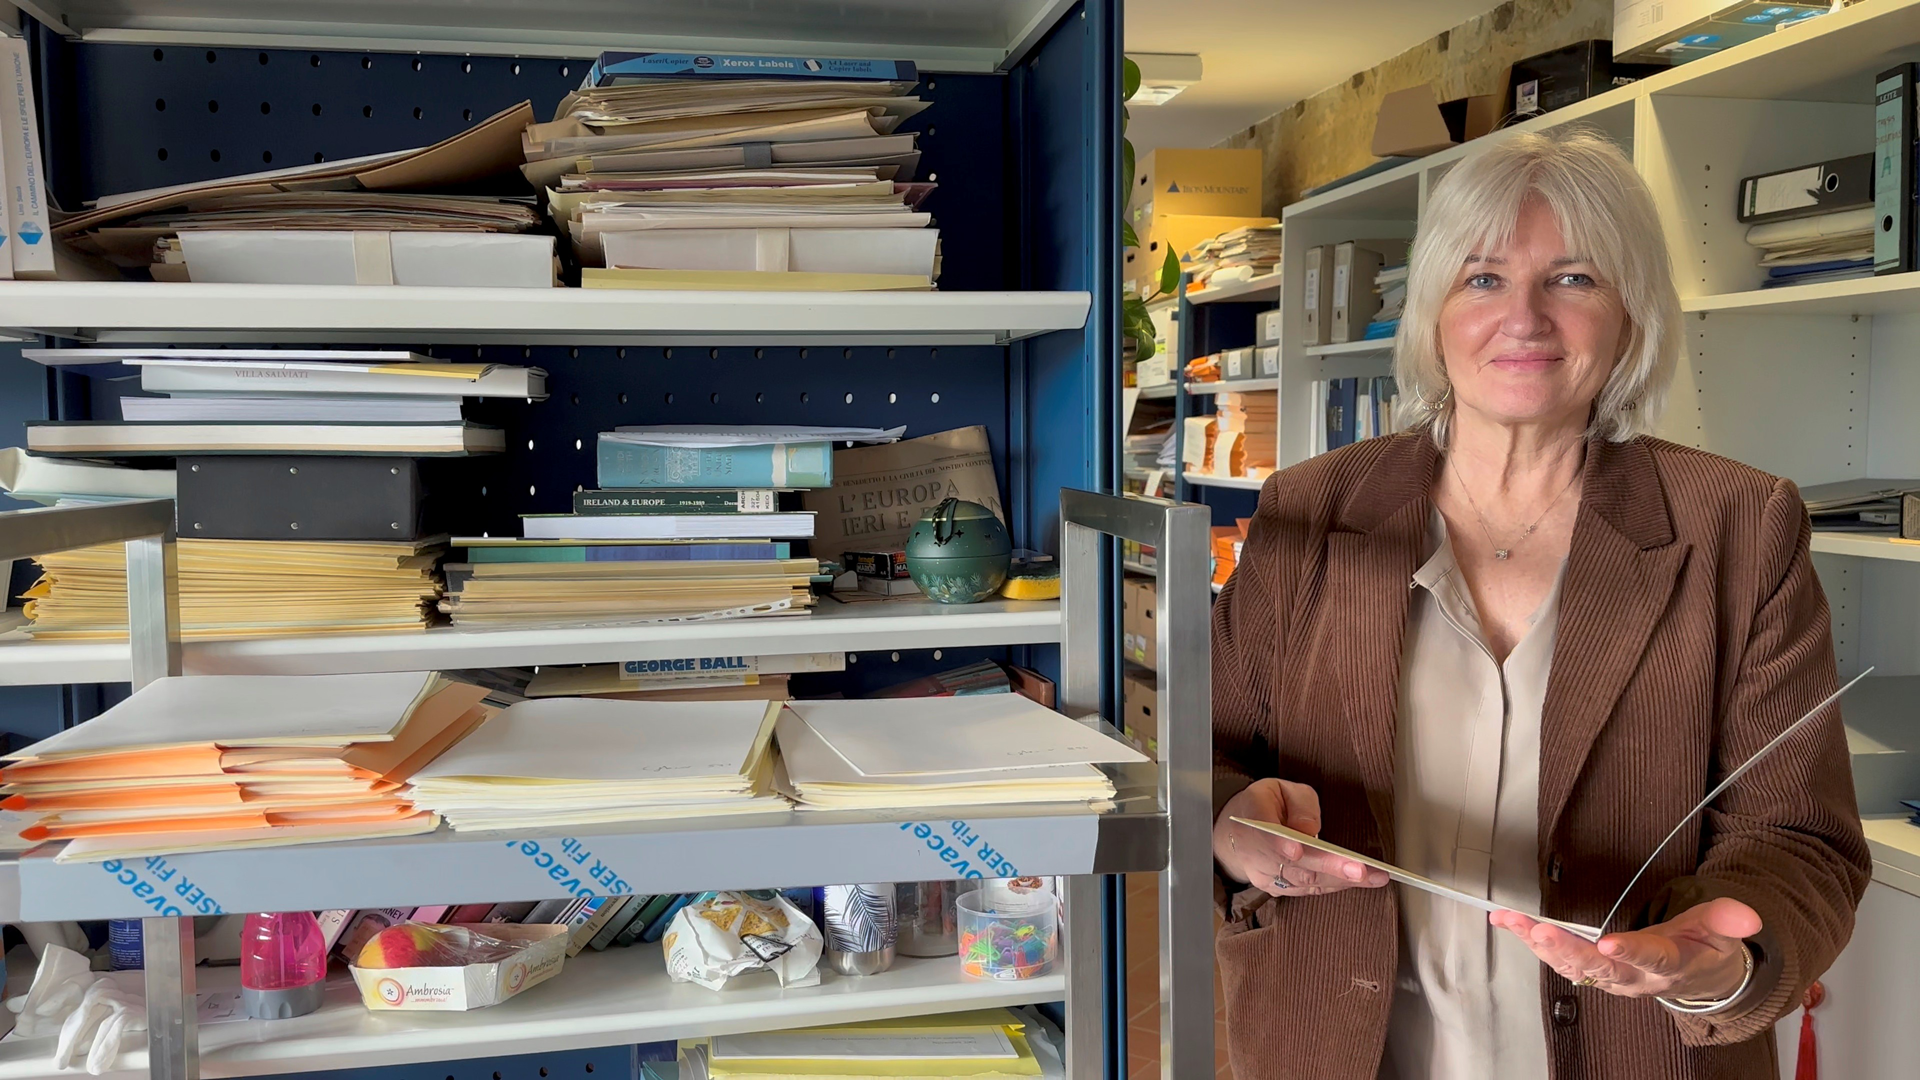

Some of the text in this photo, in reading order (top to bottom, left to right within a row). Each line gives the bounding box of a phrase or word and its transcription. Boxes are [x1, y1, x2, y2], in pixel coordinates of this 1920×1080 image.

[722, 58, 755, 68] Xerox
[758, 58, 794, 69] Labels
[1880, 90, 1898, 102] LEITZ
[29, 178, 38, 208] CAMMINO
[1183, 185, 1248, 194] IRON MOUNTAIN
[842, 476, 882, 487] BENEDETTO
[938, 463, 964, 472] NOSTRO
[583, 498, 620, 506] IRELAND
[622, 498, 630, 506] &
[632, 498, 666, 506] EUROPE
[838, 478, 960, 514] L'EUROPA
[841, 511, 911, 536] IERI E
[624, 658, 696, 673] GEORGE
[588, 858, 633, 896] SER
[406, 984, 452, 996] Ambrosia
